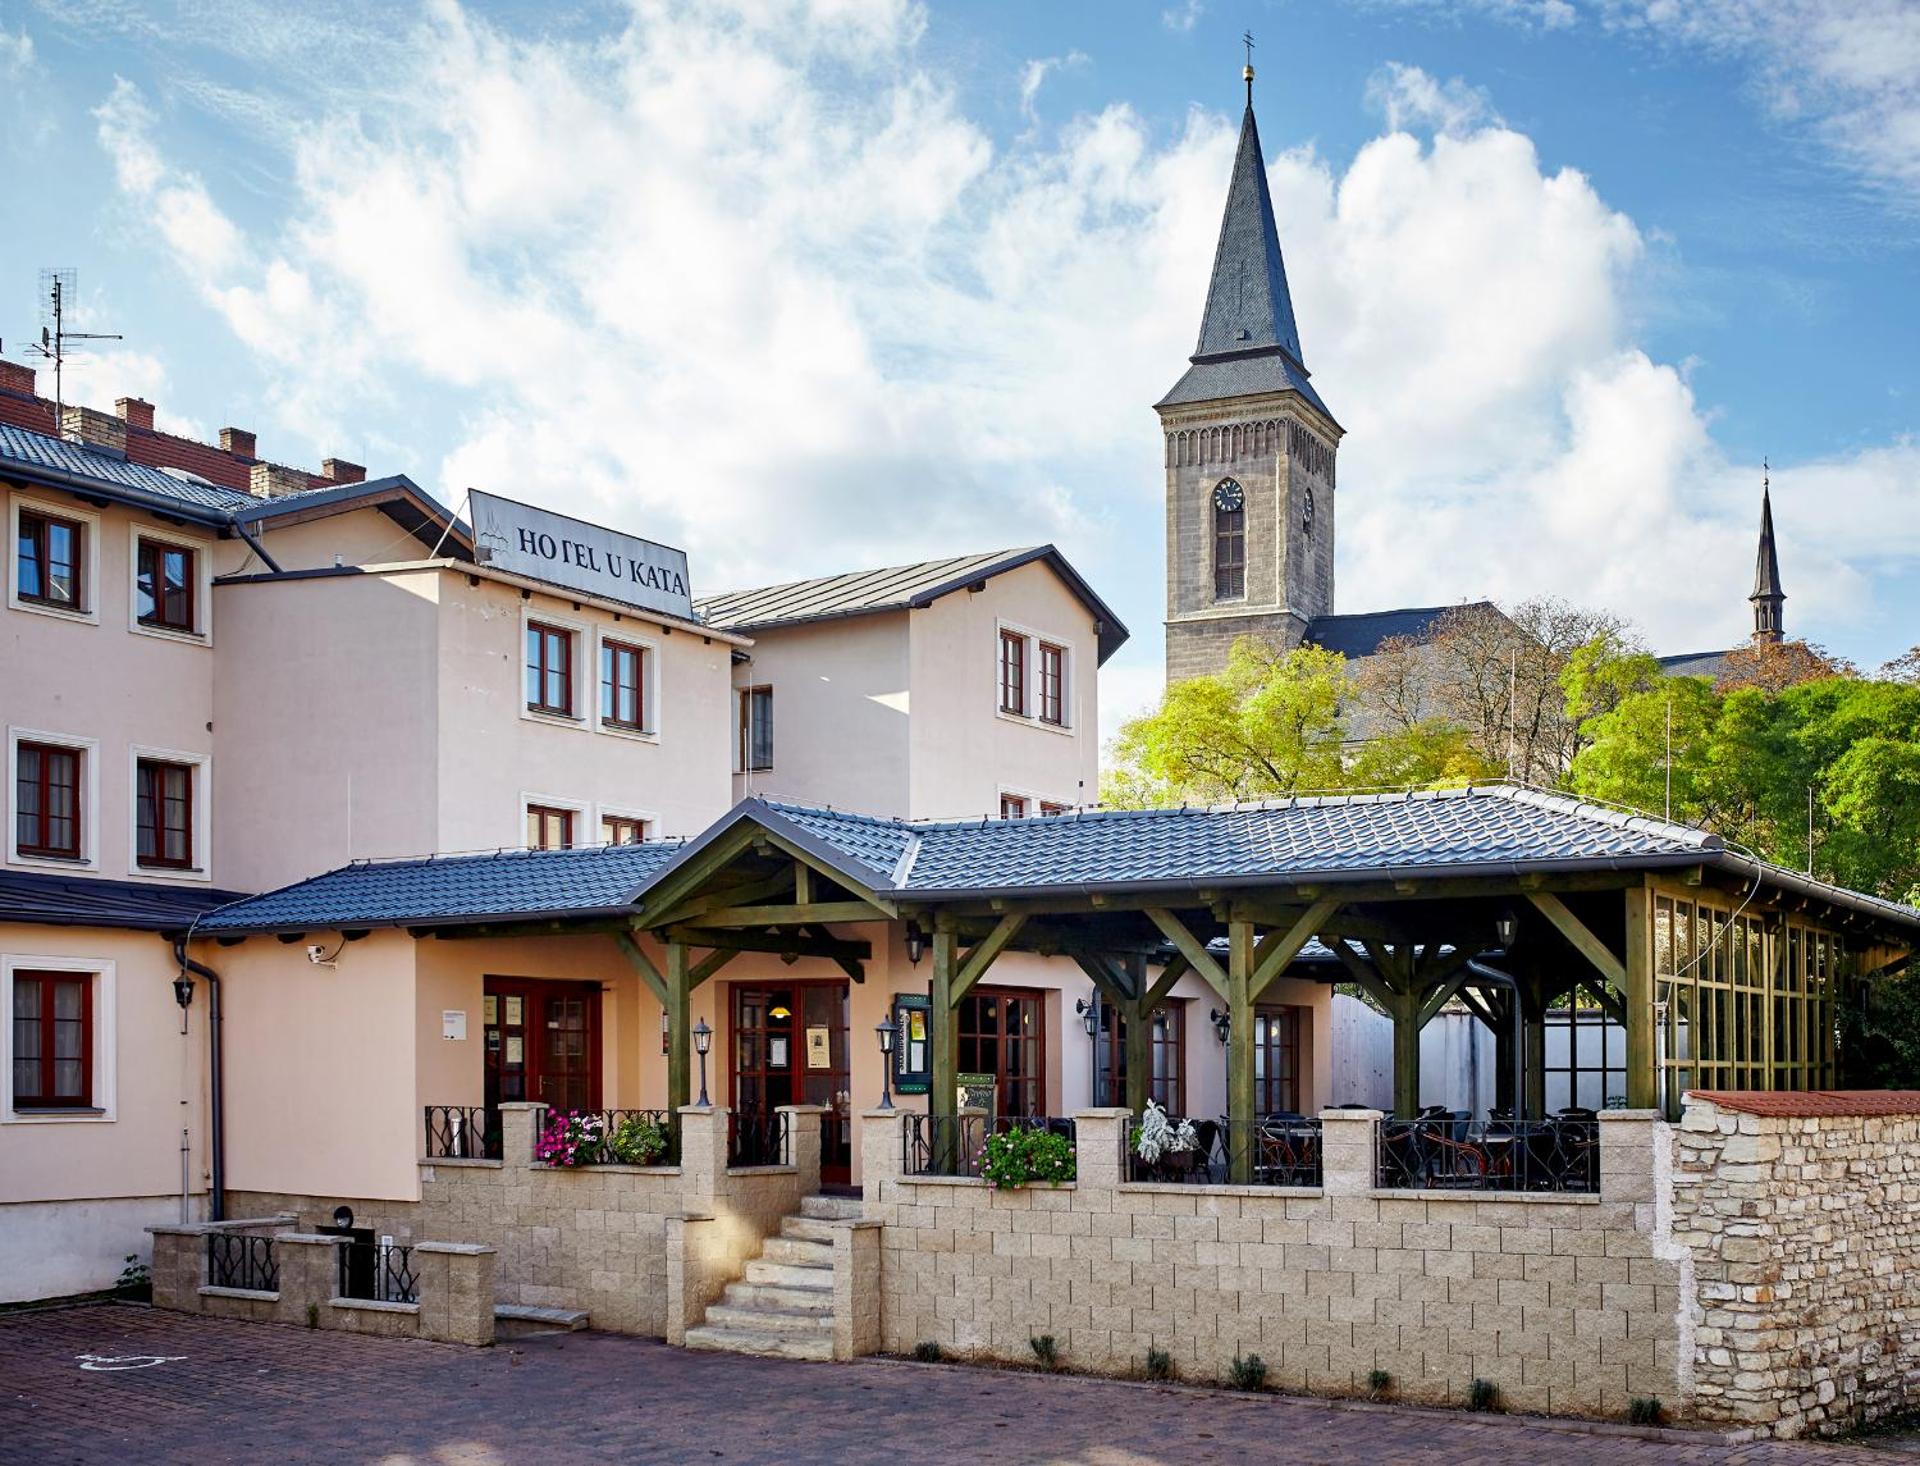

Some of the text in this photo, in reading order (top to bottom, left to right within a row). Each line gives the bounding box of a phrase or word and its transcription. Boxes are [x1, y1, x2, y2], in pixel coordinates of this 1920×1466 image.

[518, 528, 687, 597] HOTEL U KATA
